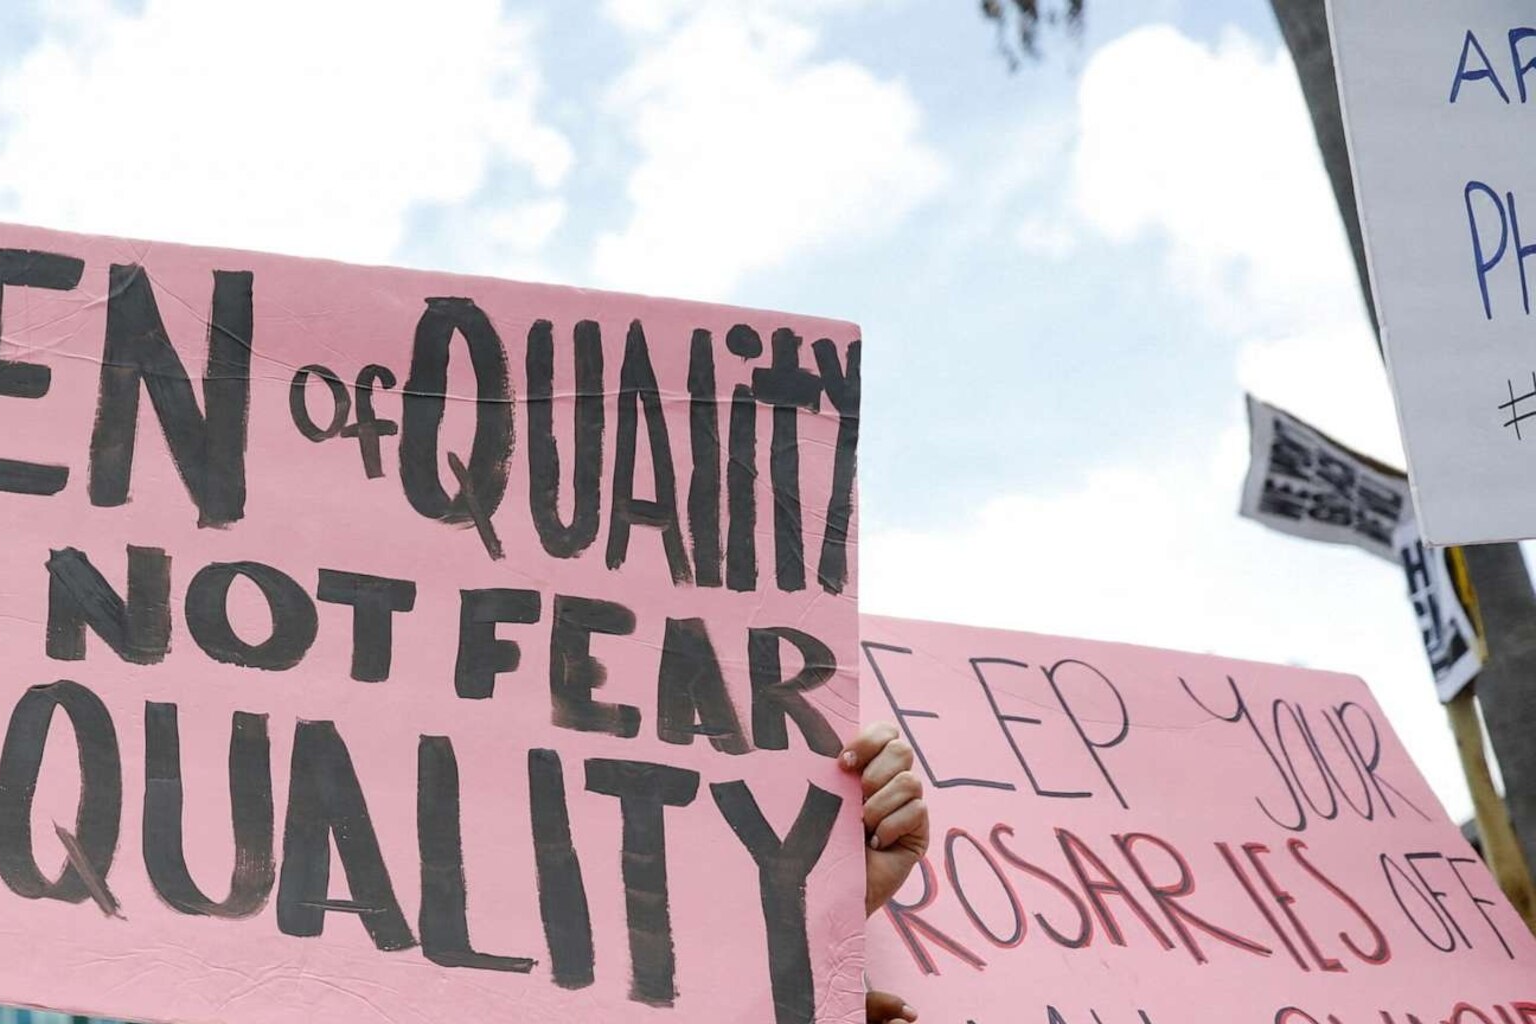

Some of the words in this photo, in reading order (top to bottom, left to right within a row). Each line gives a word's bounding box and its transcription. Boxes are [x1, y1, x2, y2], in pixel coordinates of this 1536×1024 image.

[288, 363, 399, 479] of
[44, 543, 417, 684] NOT
[454, 587, 848, 758] FEAR
[1177, 674, 1433, 832] YOUR
[882, 821, 1392, 977] ROSARIES
[1378, 850, 1516, 961] OFF
